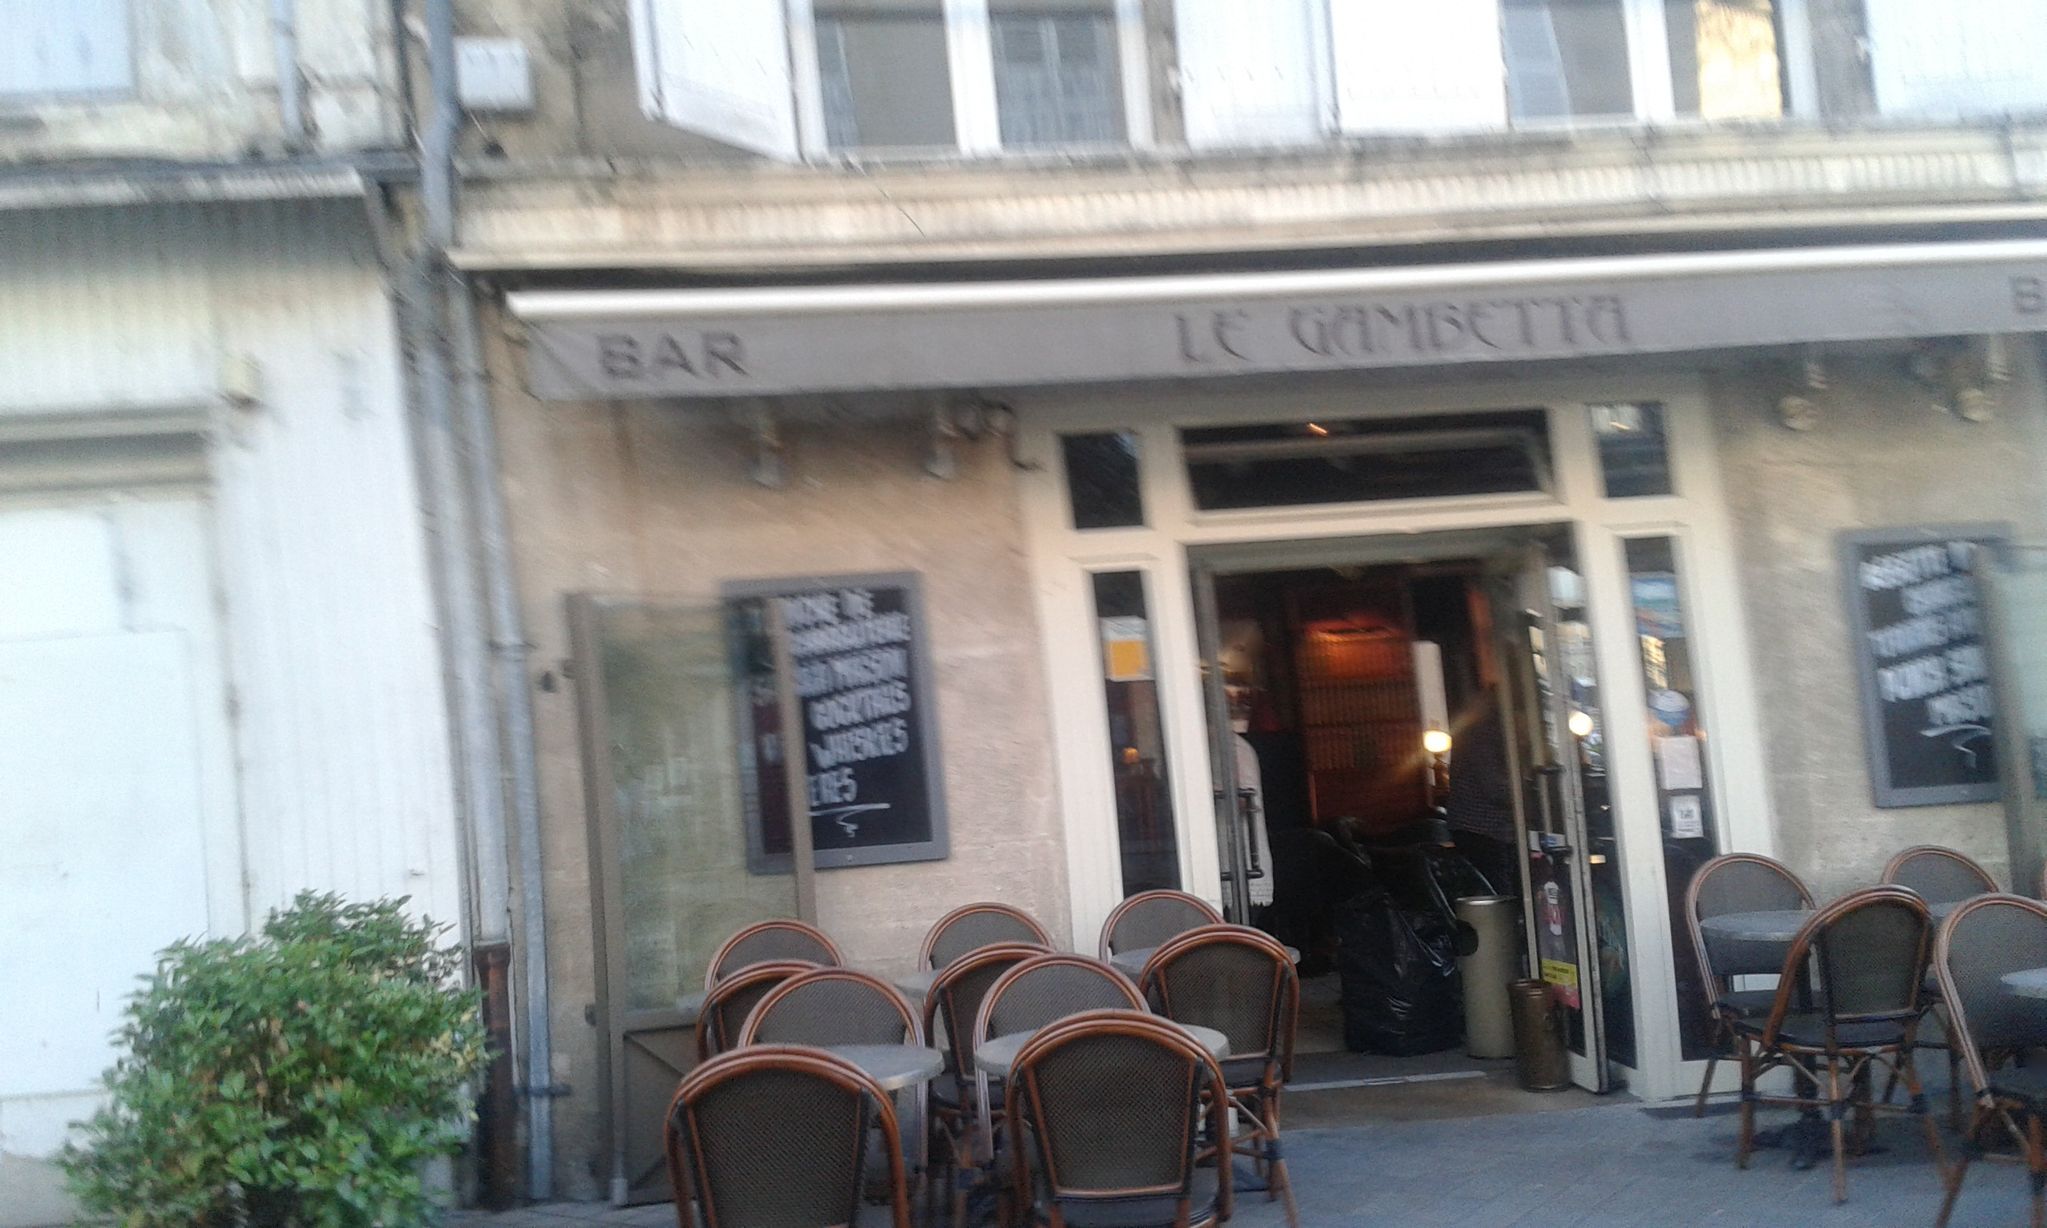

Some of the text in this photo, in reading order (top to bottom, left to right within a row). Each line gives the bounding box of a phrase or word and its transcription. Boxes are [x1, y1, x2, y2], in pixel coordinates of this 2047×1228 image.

[599, 332, 749, 380] BAR
[1174, 294, 1632, 361] LE GAMBETTA
